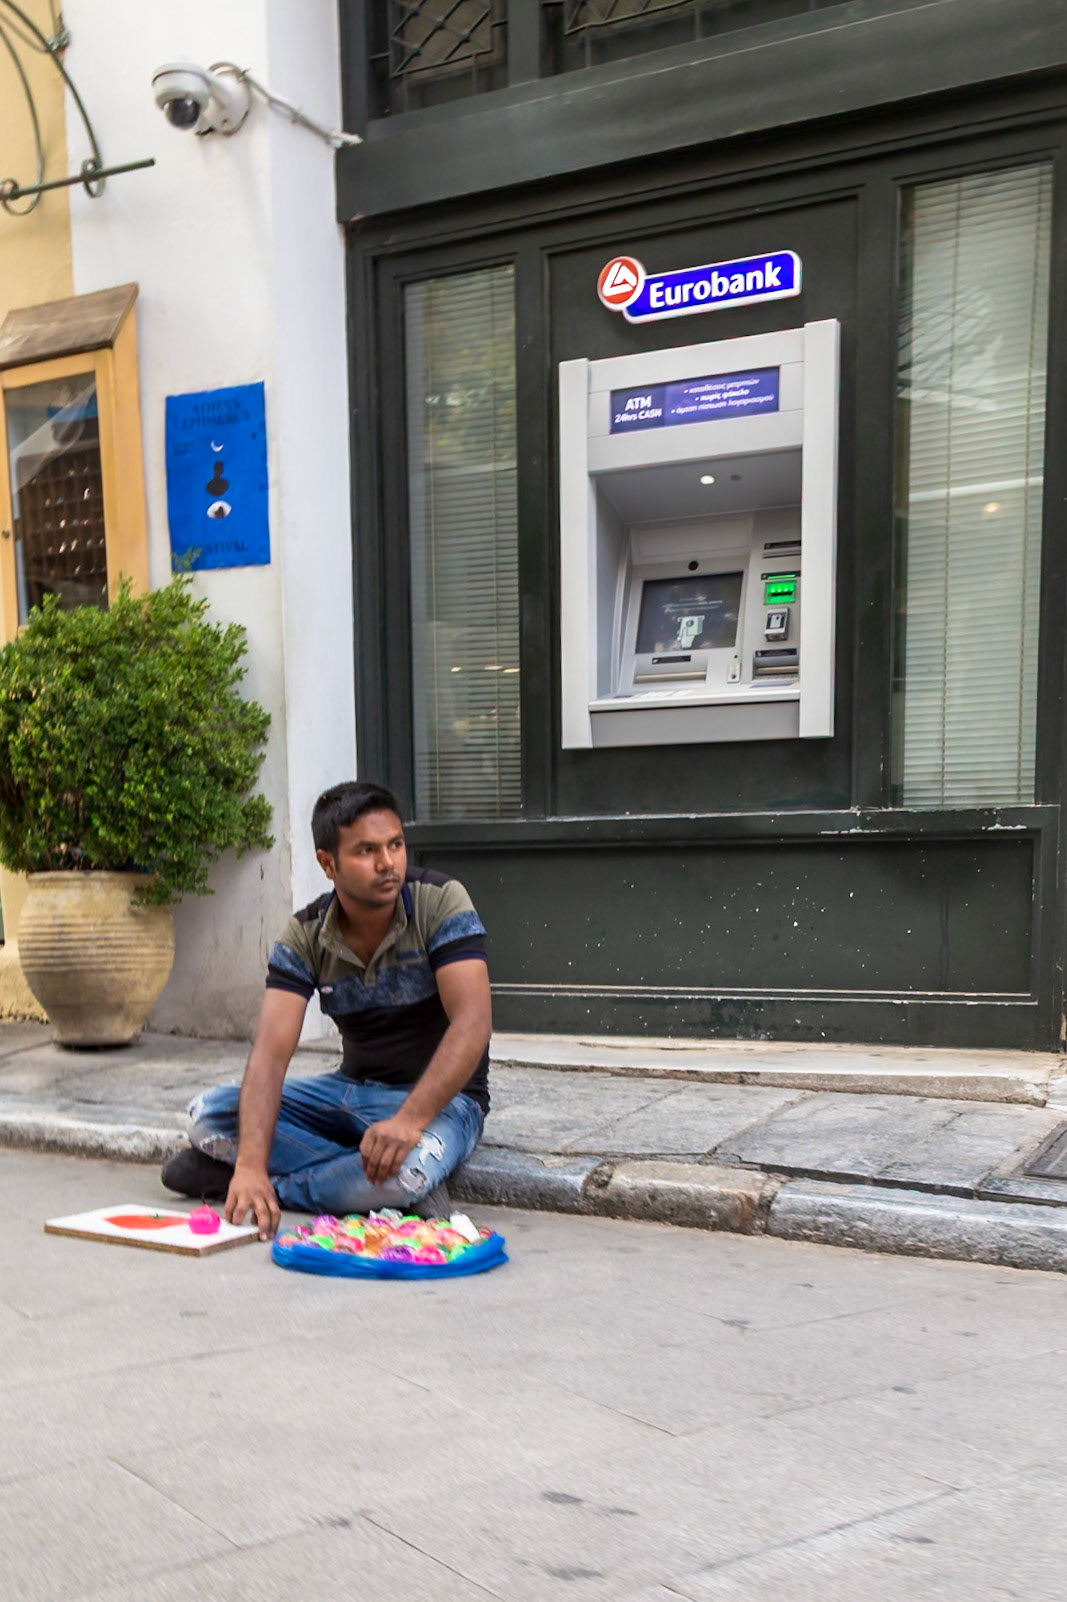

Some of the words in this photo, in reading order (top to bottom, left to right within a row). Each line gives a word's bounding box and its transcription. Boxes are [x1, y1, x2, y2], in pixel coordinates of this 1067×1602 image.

[649, 261, 783, 309] Eurobank
[624, 395, 652, 411] ATM
[614, 411, 638, 423] 24hrs
[638, 407, 662, 420] CASH
